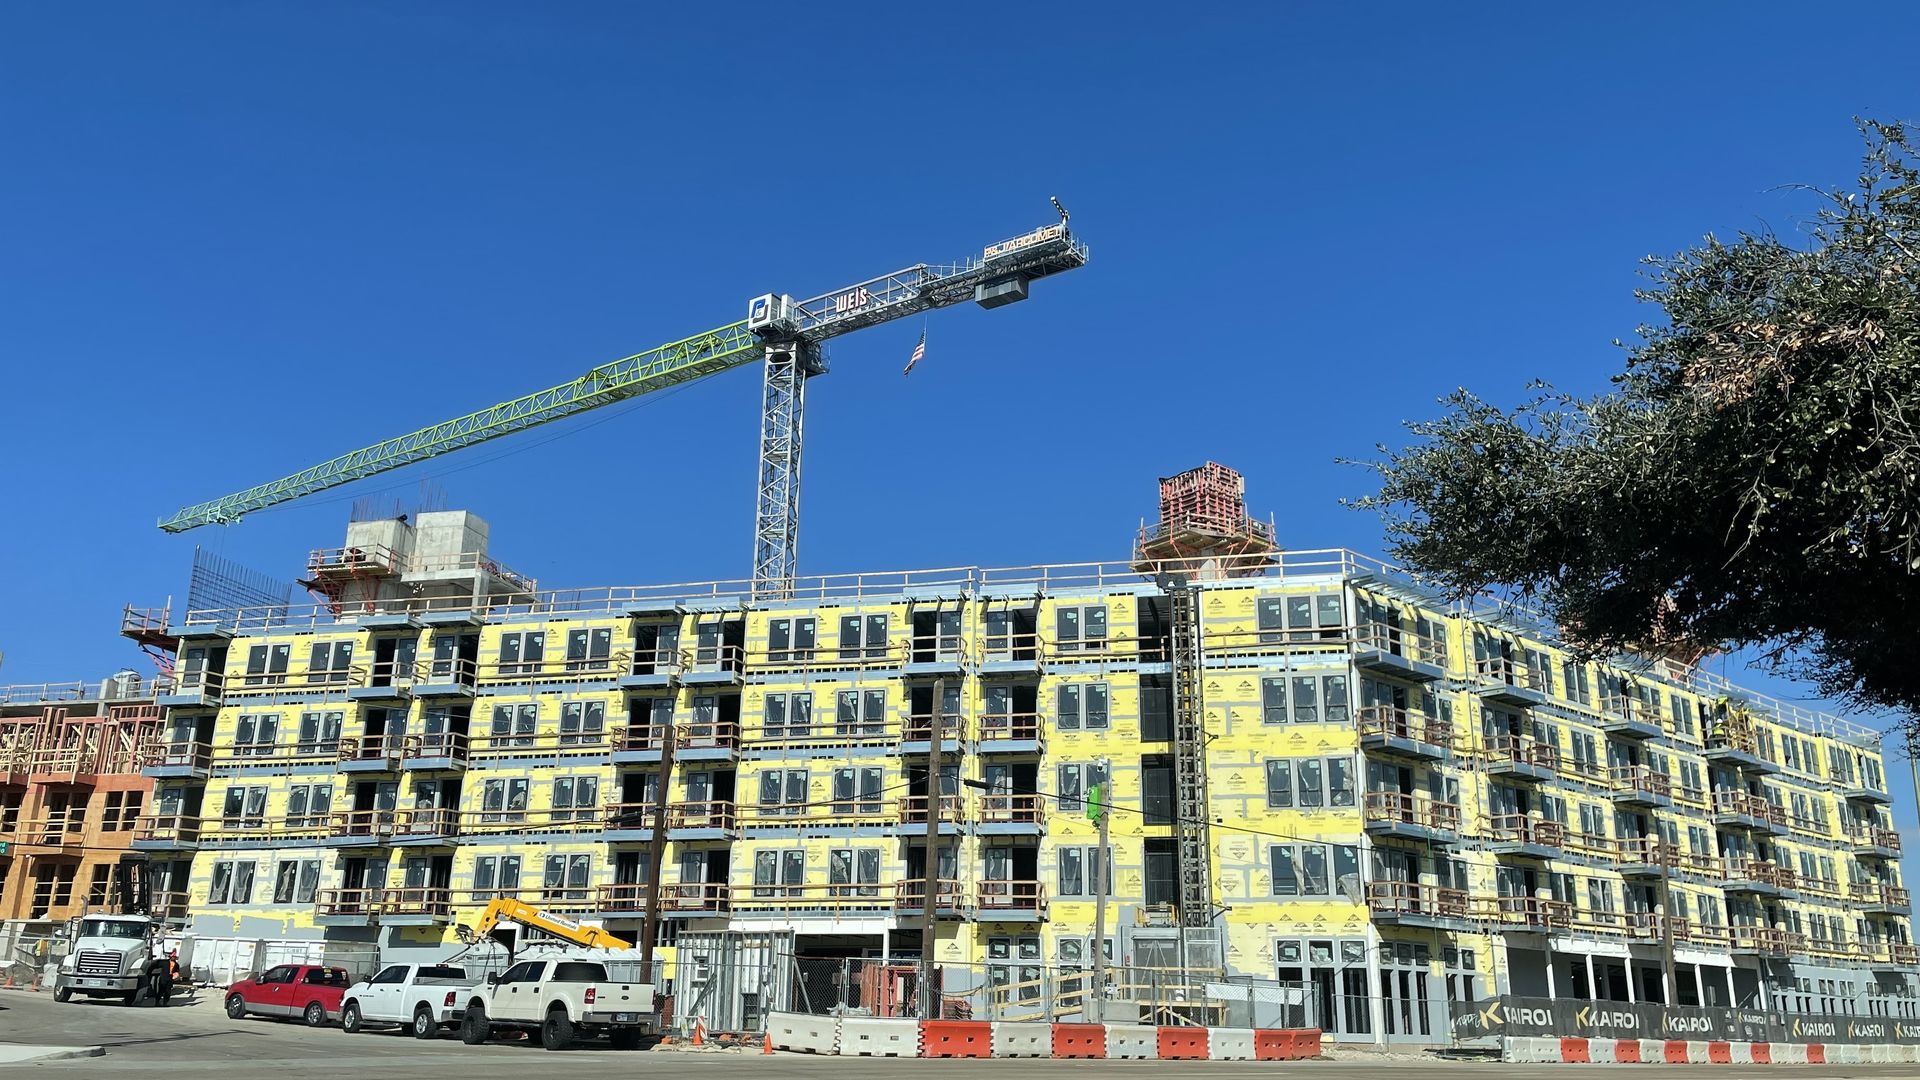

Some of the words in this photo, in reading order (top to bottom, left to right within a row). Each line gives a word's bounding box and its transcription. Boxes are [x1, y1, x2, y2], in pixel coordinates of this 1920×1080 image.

[835, 287, 868, 313] WEIS
[545, 914, 561, 924] United
[560, 919, 577, 930] Rentals
[1589, 1010, 1640, 1029] KAIROI
[1668, 1016, 1714, 1033] KAIROI
[1801, 1022, 1836, 1037] KAIROI
[1854, 1024, 1885, 1037] KAIROI
